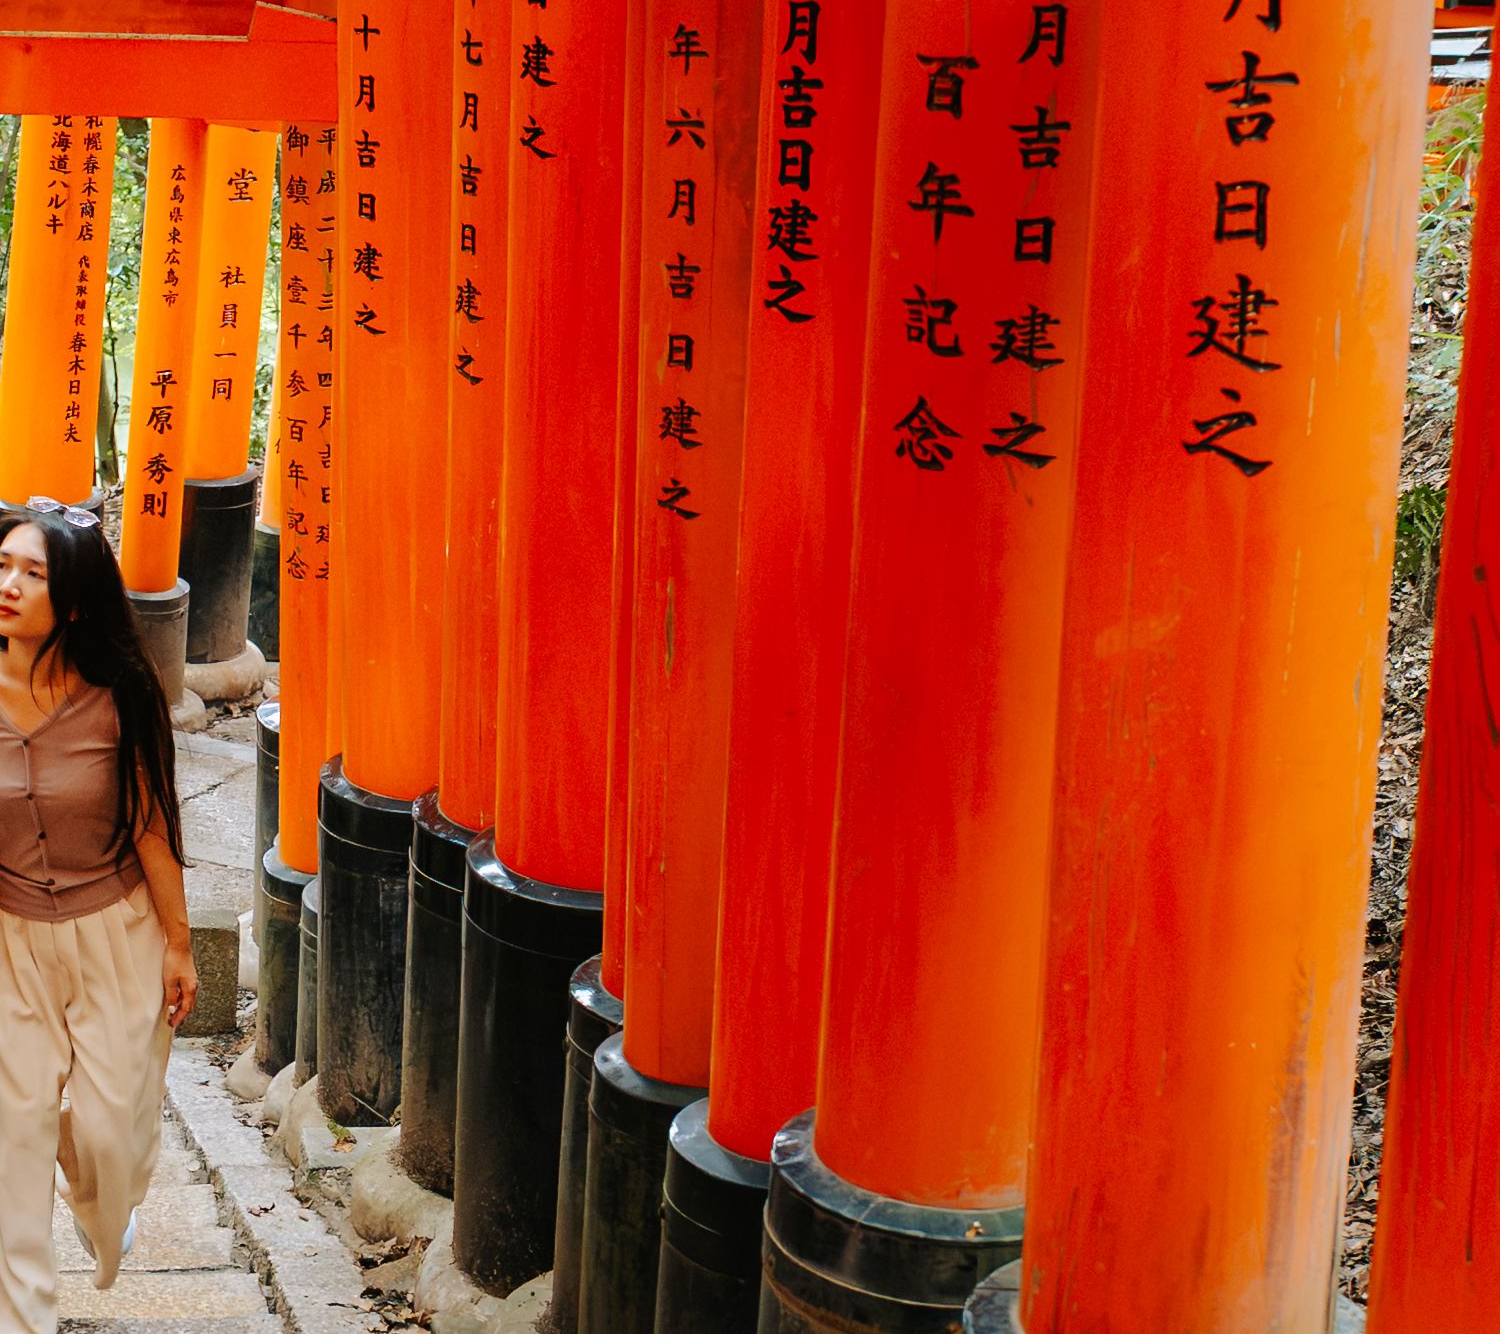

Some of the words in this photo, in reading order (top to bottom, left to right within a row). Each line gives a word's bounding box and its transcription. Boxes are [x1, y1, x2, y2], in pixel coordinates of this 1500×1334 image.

[163, 165, 186, 306] 広島県東広島市
[227, 168, 258, 201] 堂
[211, 266, 246, 400] 社員一同
[141, 369, 177, 518] 平原秀則
